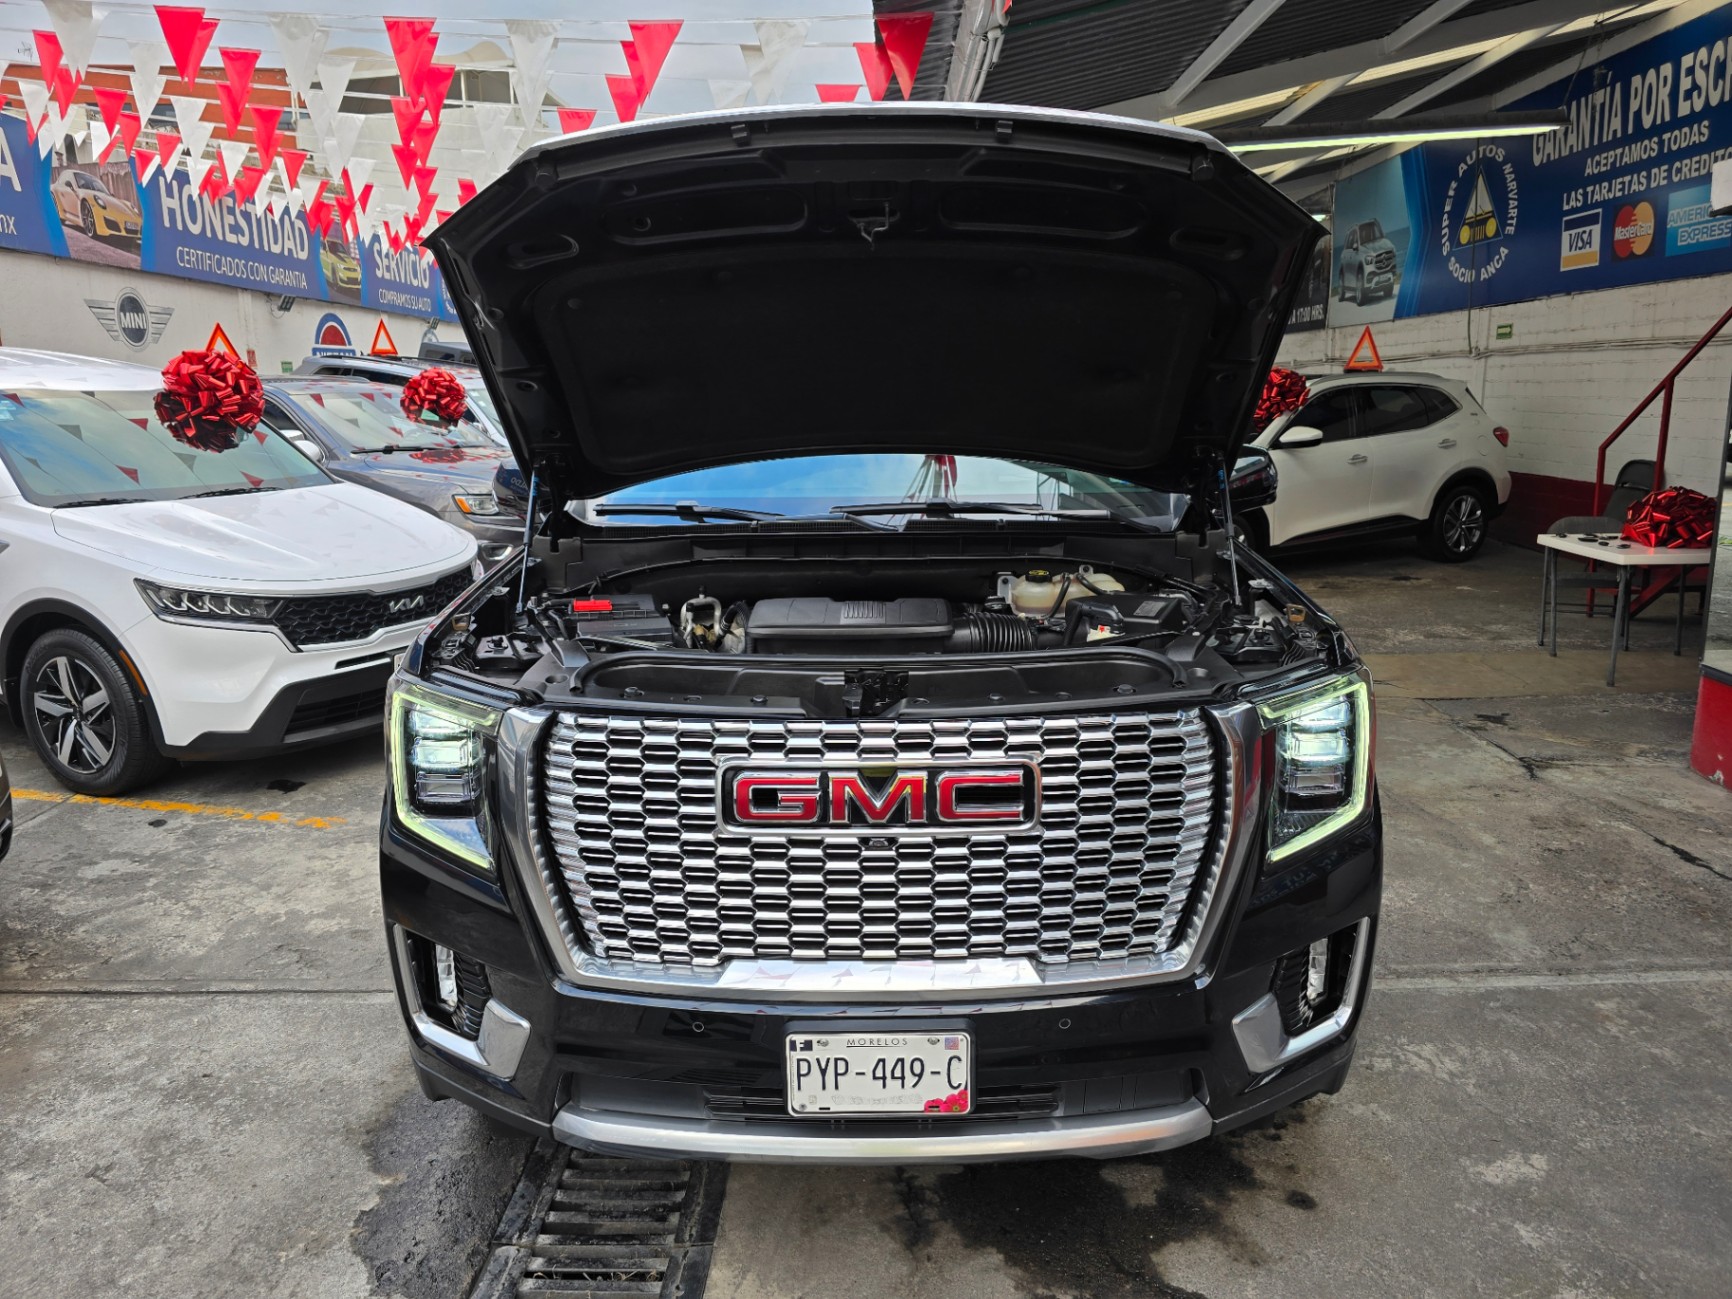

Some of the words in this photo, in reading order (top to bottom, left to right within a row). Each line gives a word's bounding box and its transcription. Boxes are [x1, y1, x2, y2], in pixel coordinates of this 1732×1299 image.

[1532, 71, 1622, 167] GARANTÍA
[1627, 62, 1672, 135] POR
[1584, 132, 1659, 177] ACEPTAMOS
[1662, 120, 1710, 154] TODAS
[1441, 180, 1458, 256] SUPER
[1458, 144, 1505, 178] AUTOS
[1502, 162, 1518, 236] NARVARTE
[1563, 191, 1584, 211] LAS
[1586, 171, 1648, 204] TARJETAS
[1650, 165, 1669, 189] DE
[158, 176, 309, 261] HONESTIDAD
[1568, 229, 1593, 253] VISA
[1678, 221, 1732, 245] EXPRESS
[176, 246, 247, 279] CERTIFICADOS
[248, 261, 268, 283] CON
[268, 265, 308, 290] GARANTIA
[373, 242, 430, 289] SERVICIO
[1448, 256, 1476, 283] SOCIO
[1480, 246, 1509, 281] ANCA
[120, 311, 147, 329] MINI
[733, 770, 1025, 824] GMC
[846, 1037, 909, 1046] MORELOS
[796, 1055, 963, 1091] PYP-449-C
